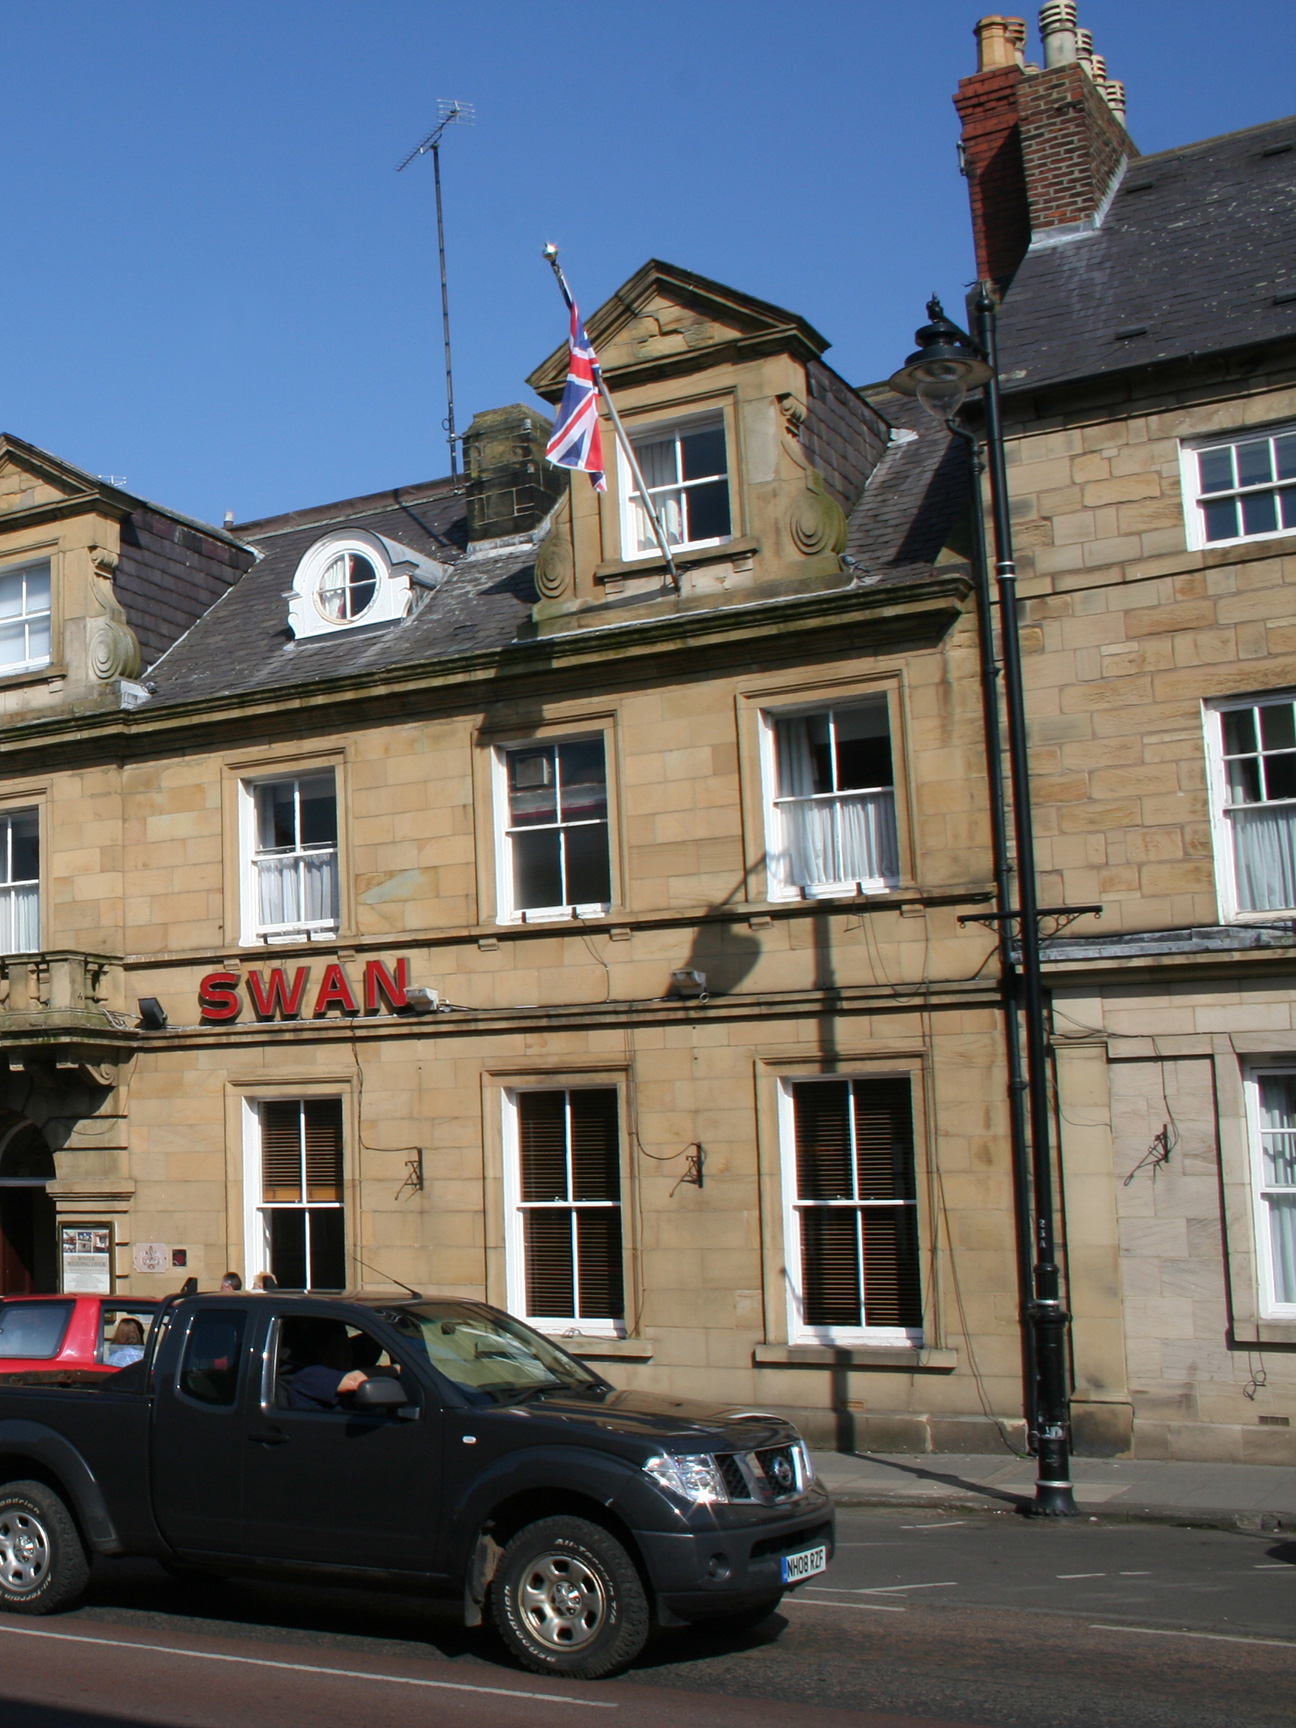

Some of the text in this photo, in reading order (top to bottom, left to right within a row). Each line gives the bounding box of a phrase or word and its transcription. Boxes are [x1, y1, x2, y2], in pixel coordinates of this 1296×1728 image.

[199, 957, 409, 1020] SWAN
[787, 1549, 823, 1578] NH08 RZF
